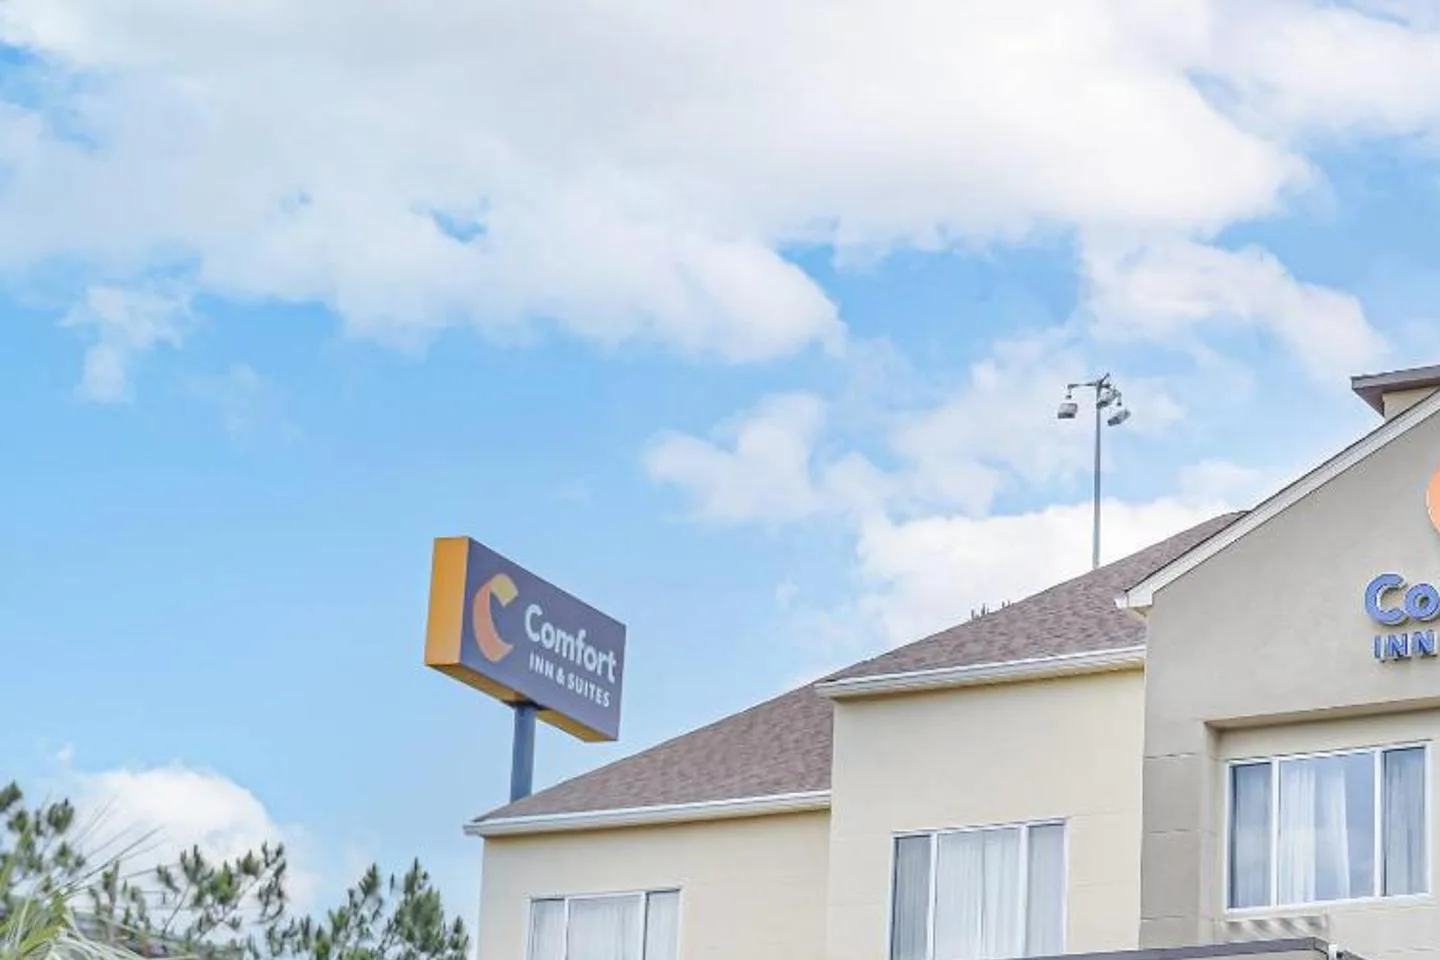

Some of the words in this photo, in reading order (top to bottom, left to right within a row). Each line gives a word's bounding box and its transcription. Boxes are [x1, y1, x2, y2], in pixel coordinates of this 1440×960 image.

[524, 603, 616, 684] Comfort
[1373, 628, 1438, 662] INN
[529, 651, 554, 681] INN
[556, 668, 566, 686] &
[568, 672, 611, 708] SUITES
